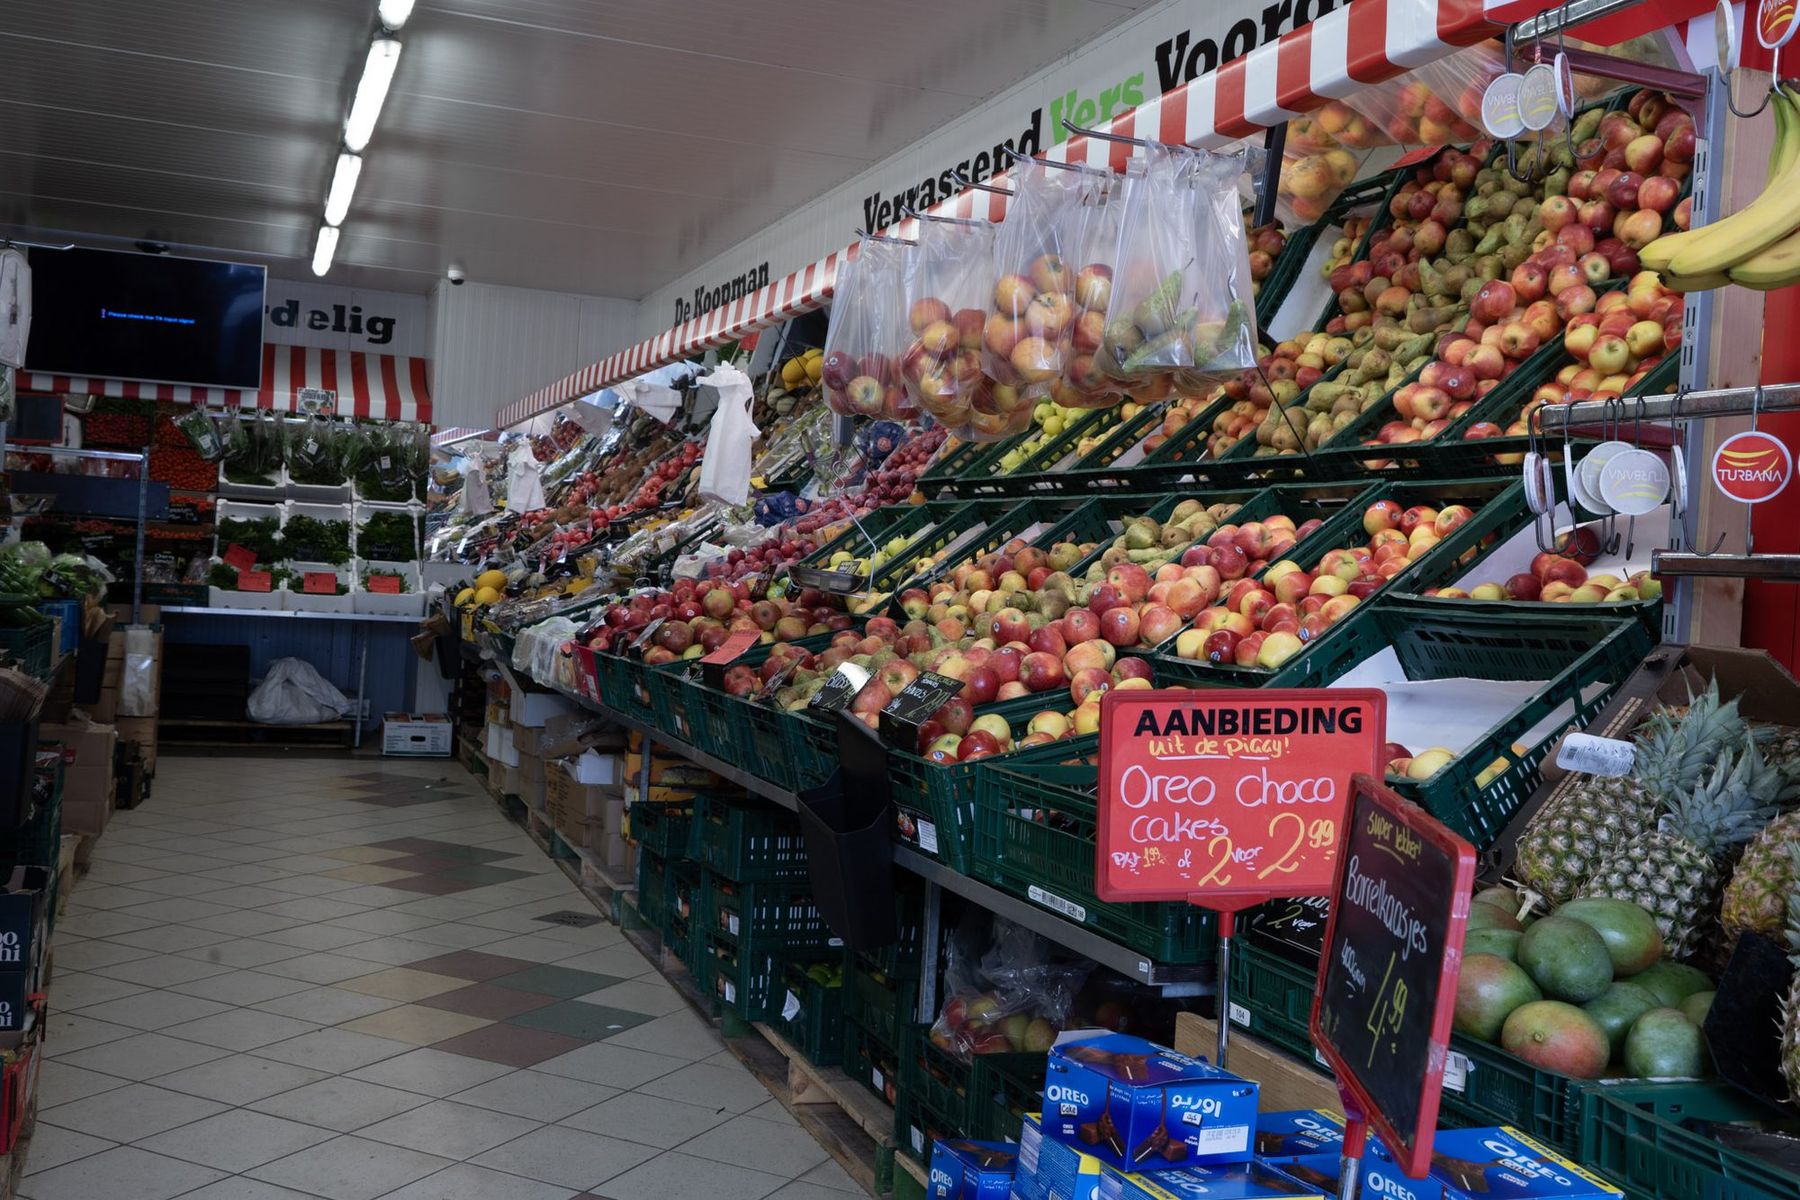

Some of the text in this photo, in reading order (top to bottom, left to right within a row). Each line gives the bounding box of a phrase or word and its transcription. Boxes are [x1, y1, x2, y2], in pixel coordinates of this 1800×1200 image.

[863, 0, 1350, 234] Verrassend Vers Voor
[674, 261, 769, 327] De Koopman
[264, 299, 396, 345] delig
[1718, 468, 1783, 483] TURBANA
[1134, 707, 1363, 737] AANBIEDING
[1194, 737, 1219, 754] de
[1120, 765, 1216, 808] Oreo
[1198, 835, 1233, 887] 2
[1047, 1085, 1089, 1106] OREO
[1061, 1104, 1077, 1114] Cake
[1172, 1093, 1222, 1119] اوريو
[1483, 1140, 1572, 1187] OREO
